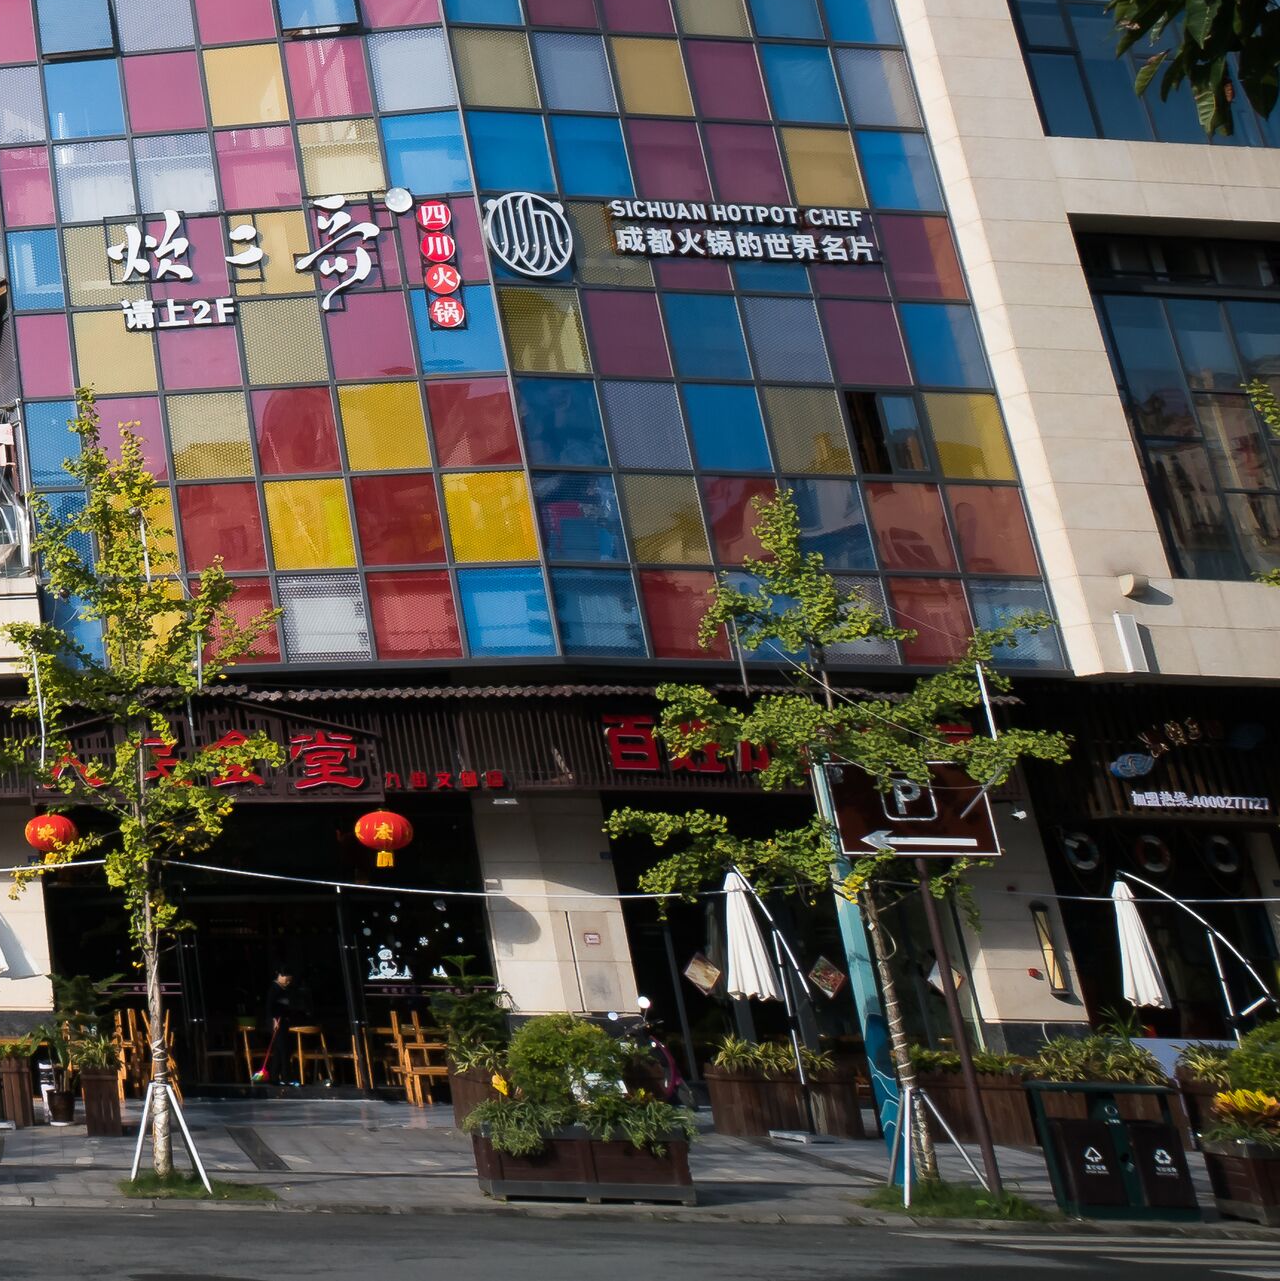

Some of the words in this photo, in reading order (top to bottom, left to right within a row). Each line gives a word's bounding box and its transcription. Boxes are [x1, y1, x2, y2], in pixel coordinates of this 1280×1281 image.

[609, 199, 708, 222] SICHUAN
[712, 204, 798, 225] HOTPOT
[807, 208, 864, 228] CHEF
[614, 226, 875, 263] 成都火锅的世界名片
[416, 200, 465, 328] 四川火锅
[121, 298, 237, 329] 请上2F
[893, 778, 921, 815] P
